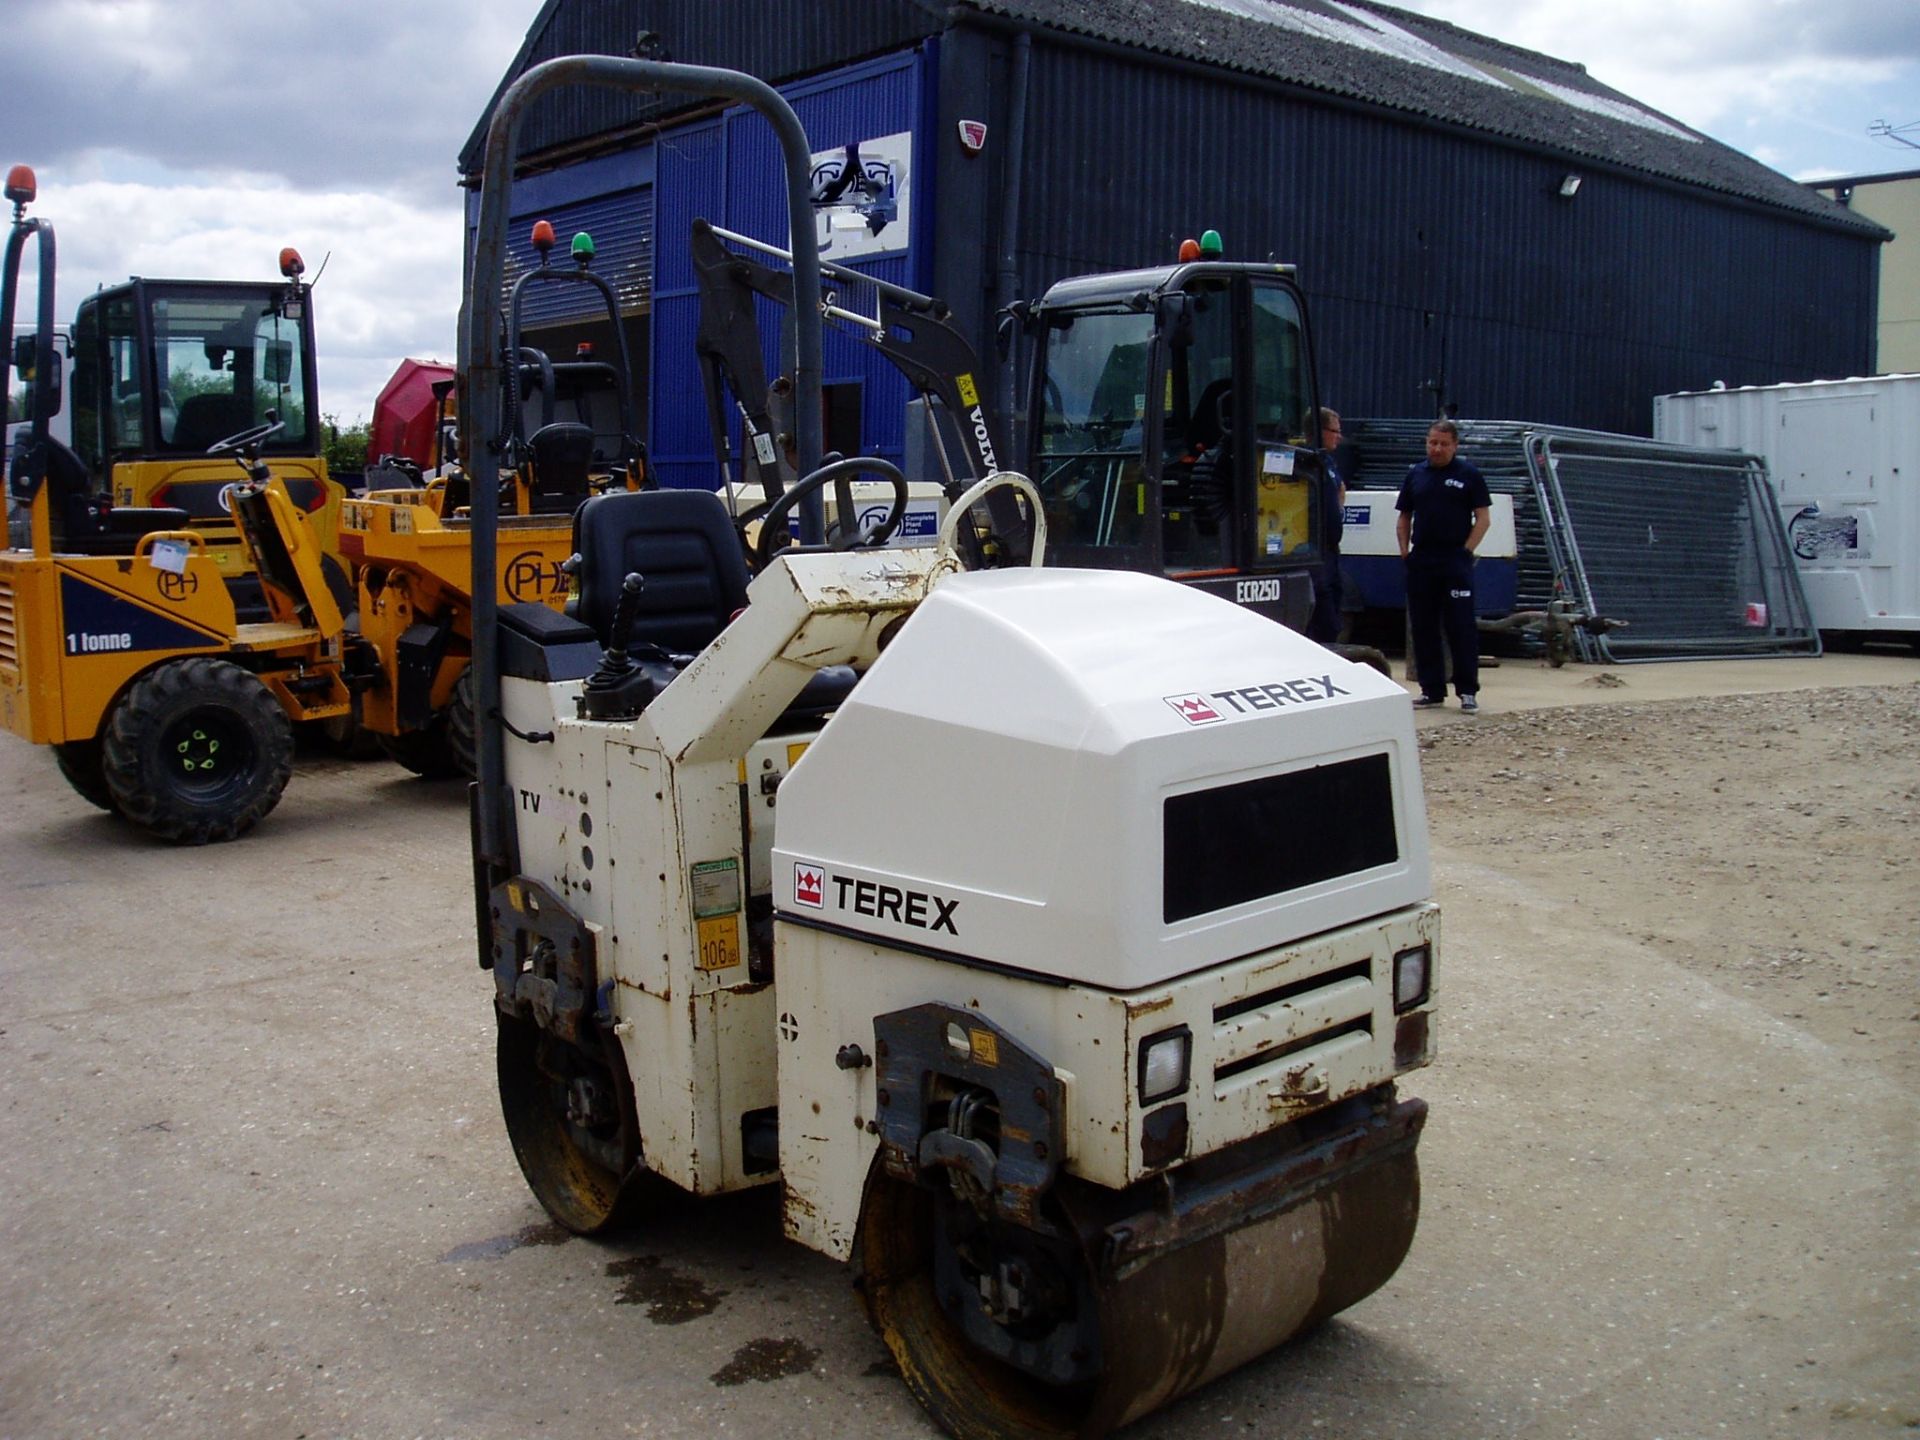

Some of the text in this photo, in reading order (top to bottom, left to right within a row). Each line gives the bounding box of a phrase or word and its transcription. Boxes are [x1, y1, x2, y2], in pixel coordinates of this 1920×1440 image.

[1236, 579, 1280, 603] ECR25D
[66, 632, 131, 652] 1 tonne
[1210, 674, 1352, 713] TEREX
[520, 789, 541, 813] TV
[832, 875, 960, 936] TEREX
[702, 939, 727, 966] 106
